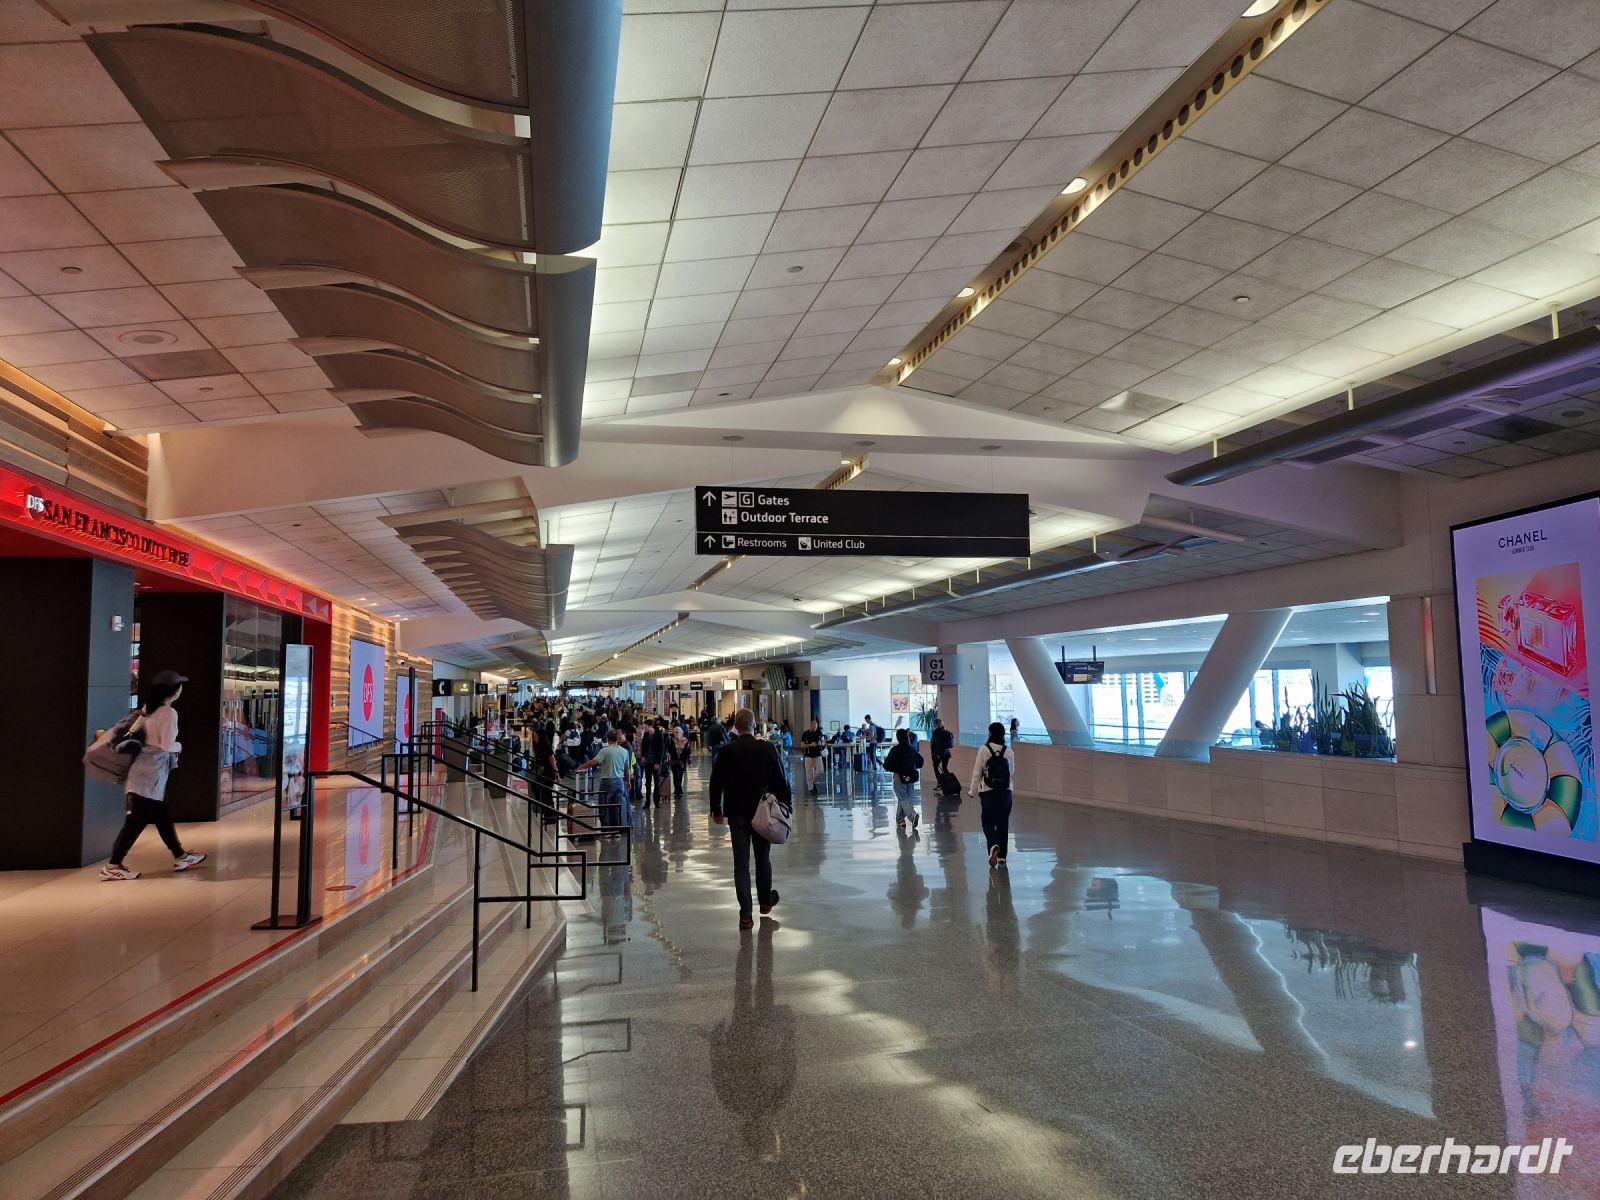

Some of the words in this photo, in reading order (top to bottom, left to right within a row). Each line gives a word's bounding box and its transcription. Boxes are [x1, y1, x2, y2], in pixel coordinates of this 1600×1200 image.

[742, 494, 751, 505] G
[757, 494, 790, 506] Gates
[741, 511, 787, 523] Outdoor
[789, 512, 829, 524] Terrace
[27, 494, 45, 512] DFS
[44, 500, 72, 527] SAN
[75, 512, 139, 550] FRANCISCO
[141, 534, 168, 561] DUTY
[168, 546, 190, 567] FREE
[737, 537, 787, 548] Restrooms
[813, 539, 843, 549] United
[845, 539, 866, 549] Club
[1498, 529, 1548, 549] CHANEL
[929, 659, 944, 670] G1
[930, 670, 945, 681] G2
